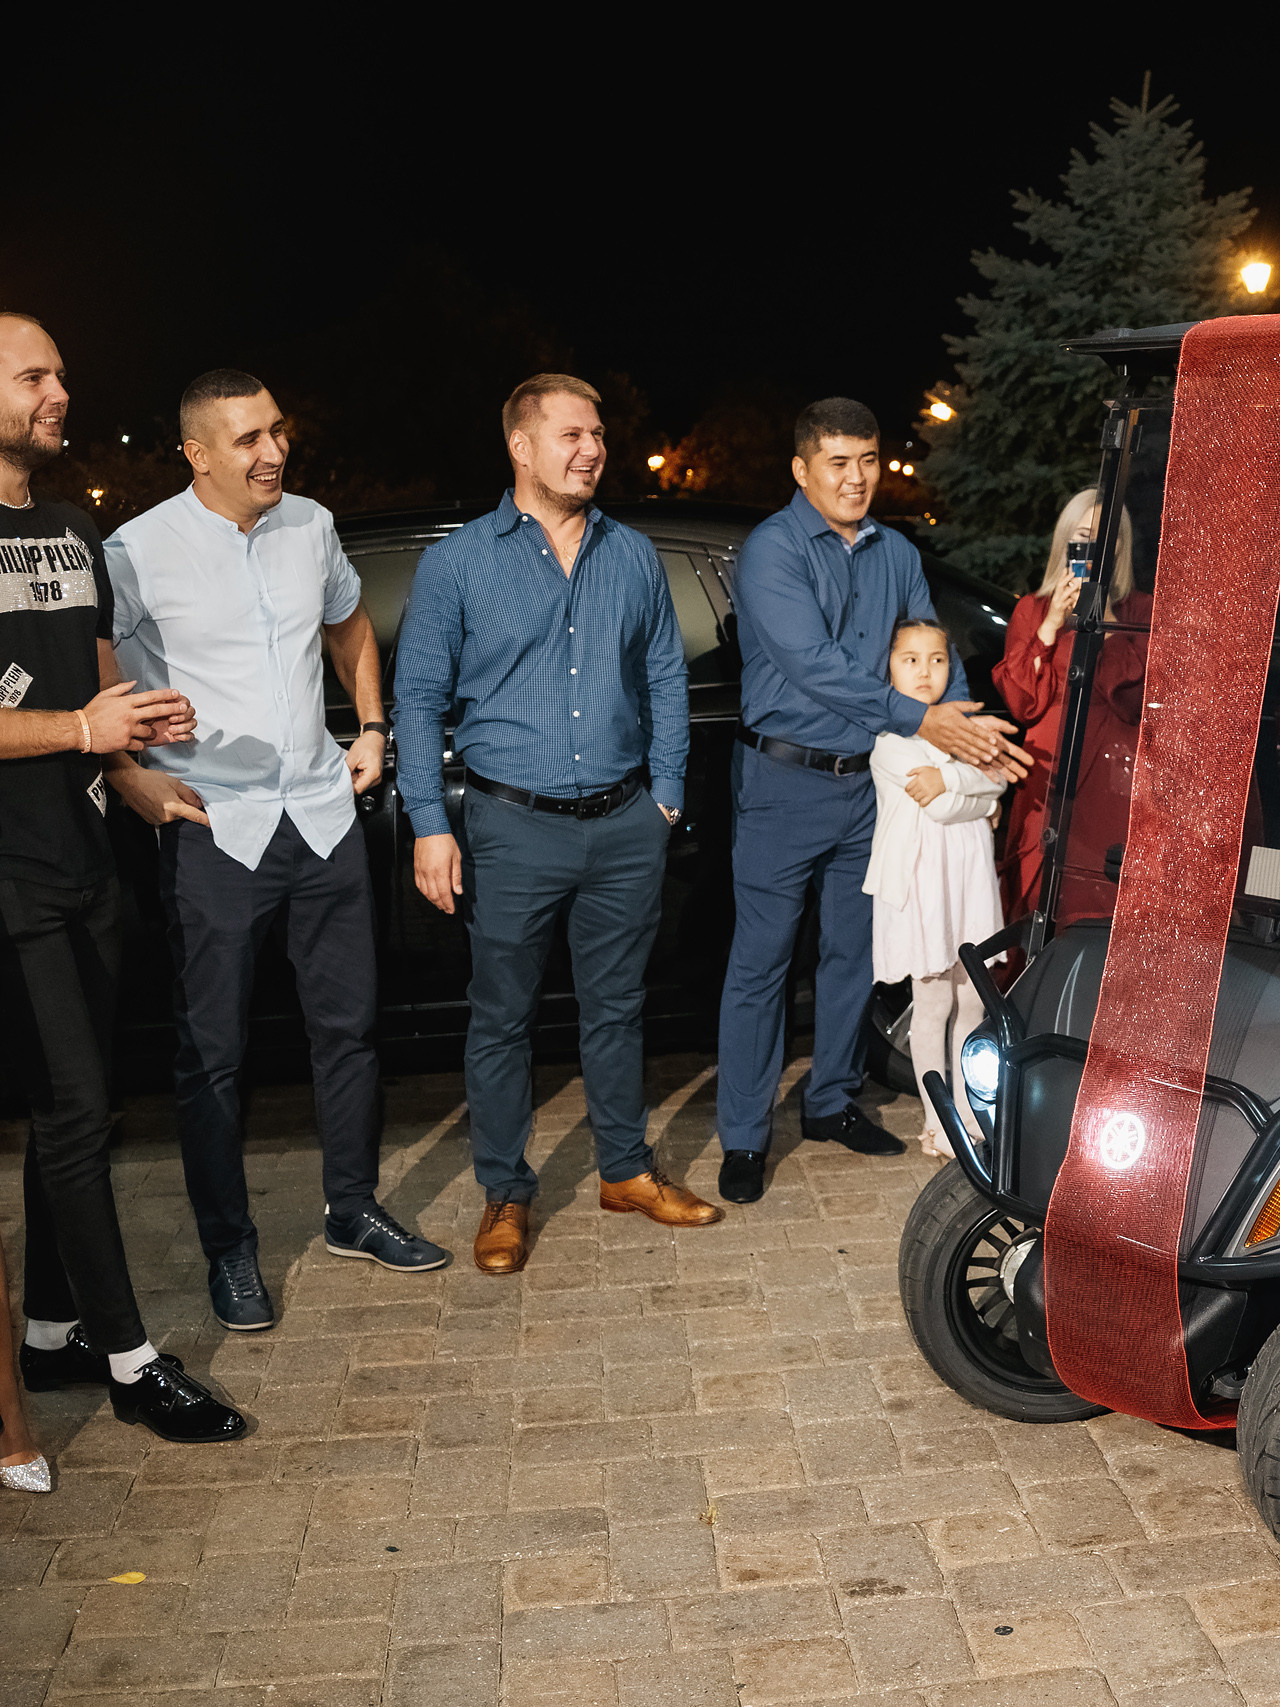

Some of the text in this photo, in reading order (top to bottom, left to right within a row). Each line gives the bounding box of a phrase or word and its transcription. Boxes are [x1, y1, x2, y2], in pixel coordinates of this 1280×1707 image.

[30, 580, 63, 603] 1978
[4, 665, 23, 688] PLEIN
[9, 690, 21, 704] 1978
